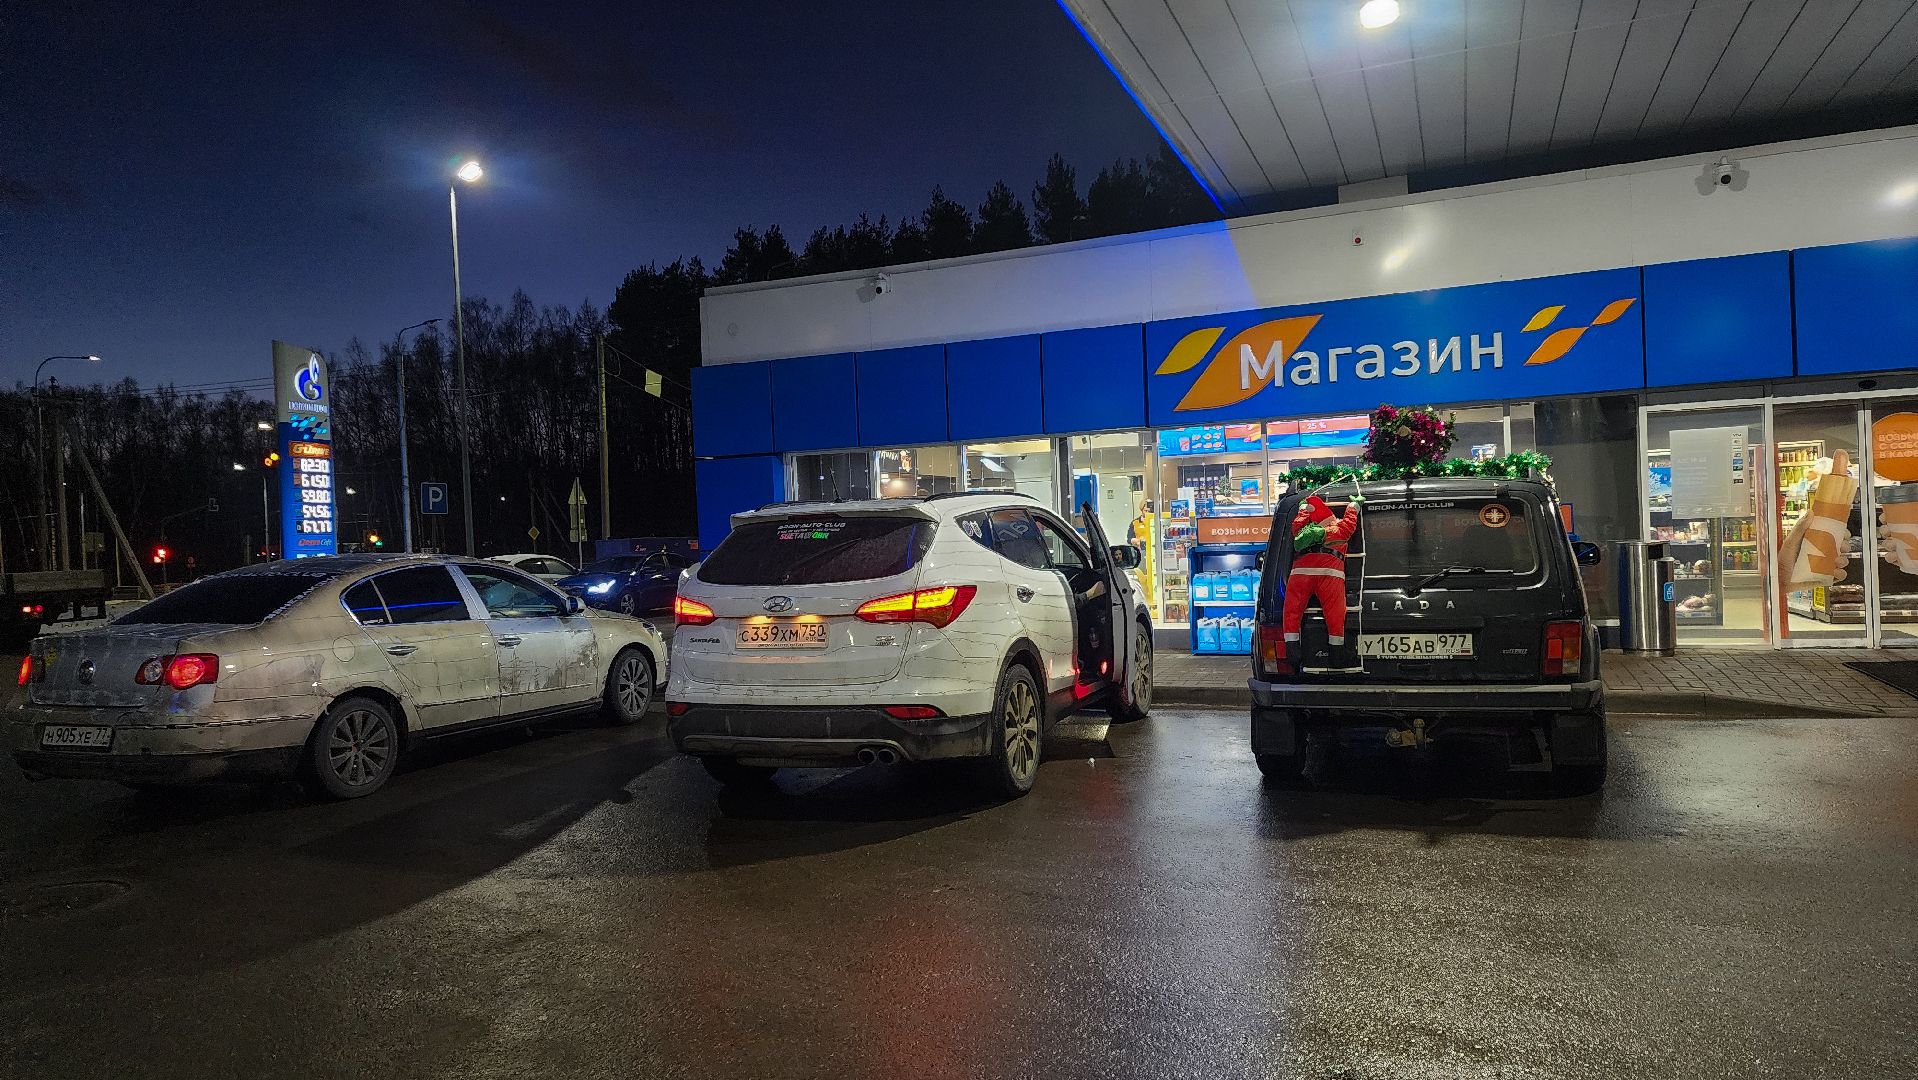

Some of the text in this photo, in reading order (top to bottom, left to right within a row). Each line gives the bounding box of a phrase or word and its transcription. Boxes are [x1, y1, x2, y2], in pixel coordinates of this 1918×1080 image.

[1240, 332, 1503, 390] Магазин
[1879, 433, 1918, 441] ВОЗЬМ
[429, 487, 443, 510] P
[1211, 528, 1250, 536] ВОЗЬМИ
[1372, 600, 1456, 611] LADA
[802, 624, 825, 637] 750
[1438, 634, 1467, 648] 977
